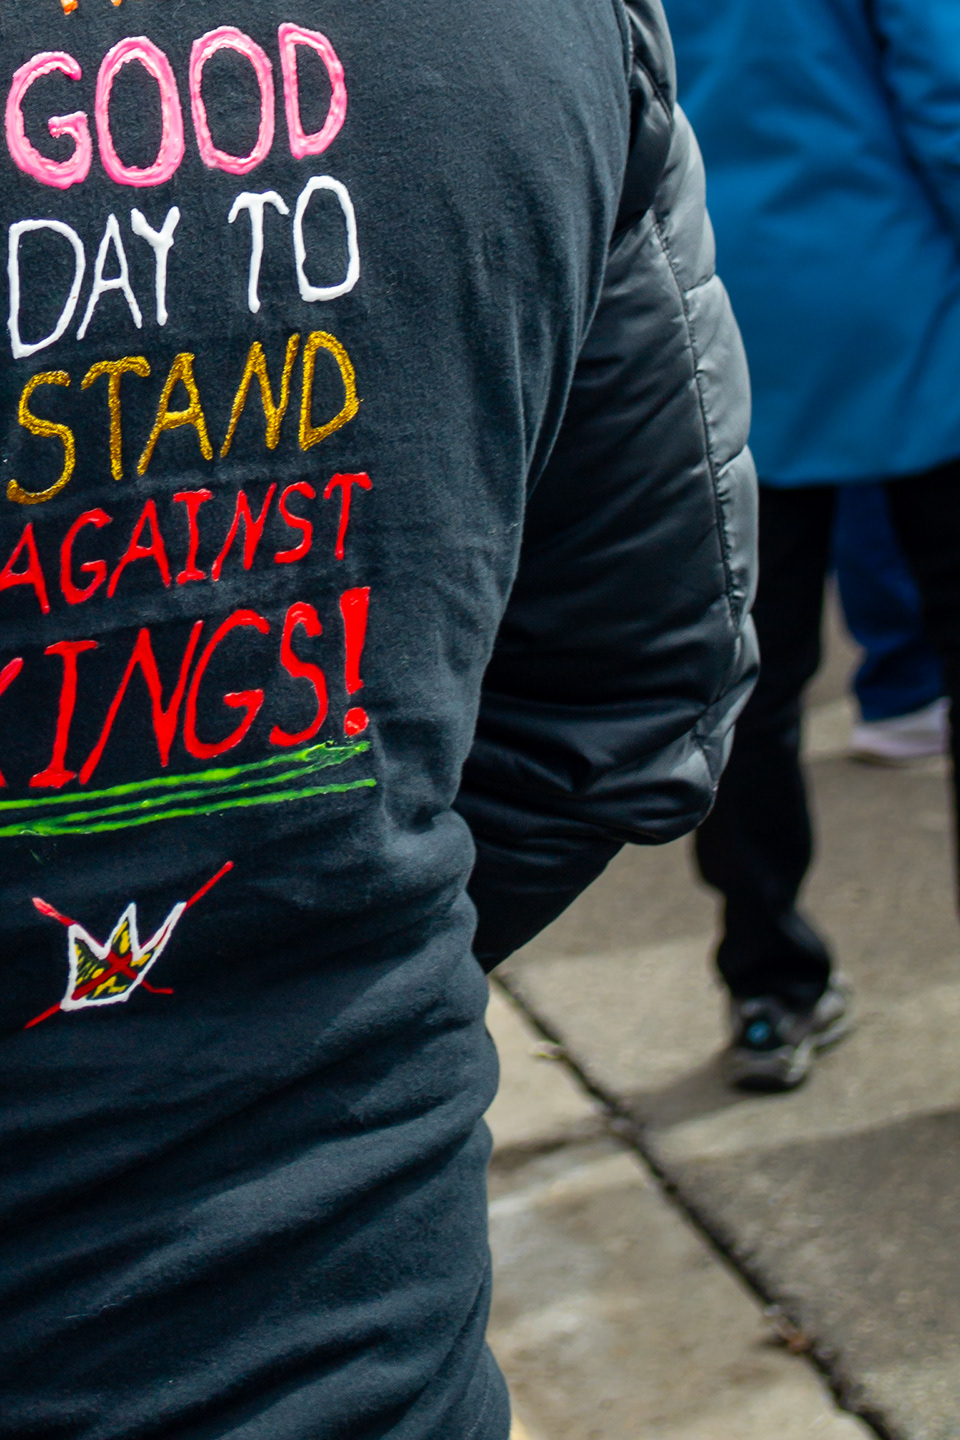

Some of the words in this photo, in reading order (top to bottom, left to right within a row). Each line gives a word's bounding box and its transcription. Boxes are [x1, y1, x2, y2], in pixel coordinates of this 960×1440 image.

[3, 21, 348, 190] GOOD
[7, 205, 181, 360] DAY
[227, 174, 361, 314] TO
[6, 330, 361, 505] STAND
